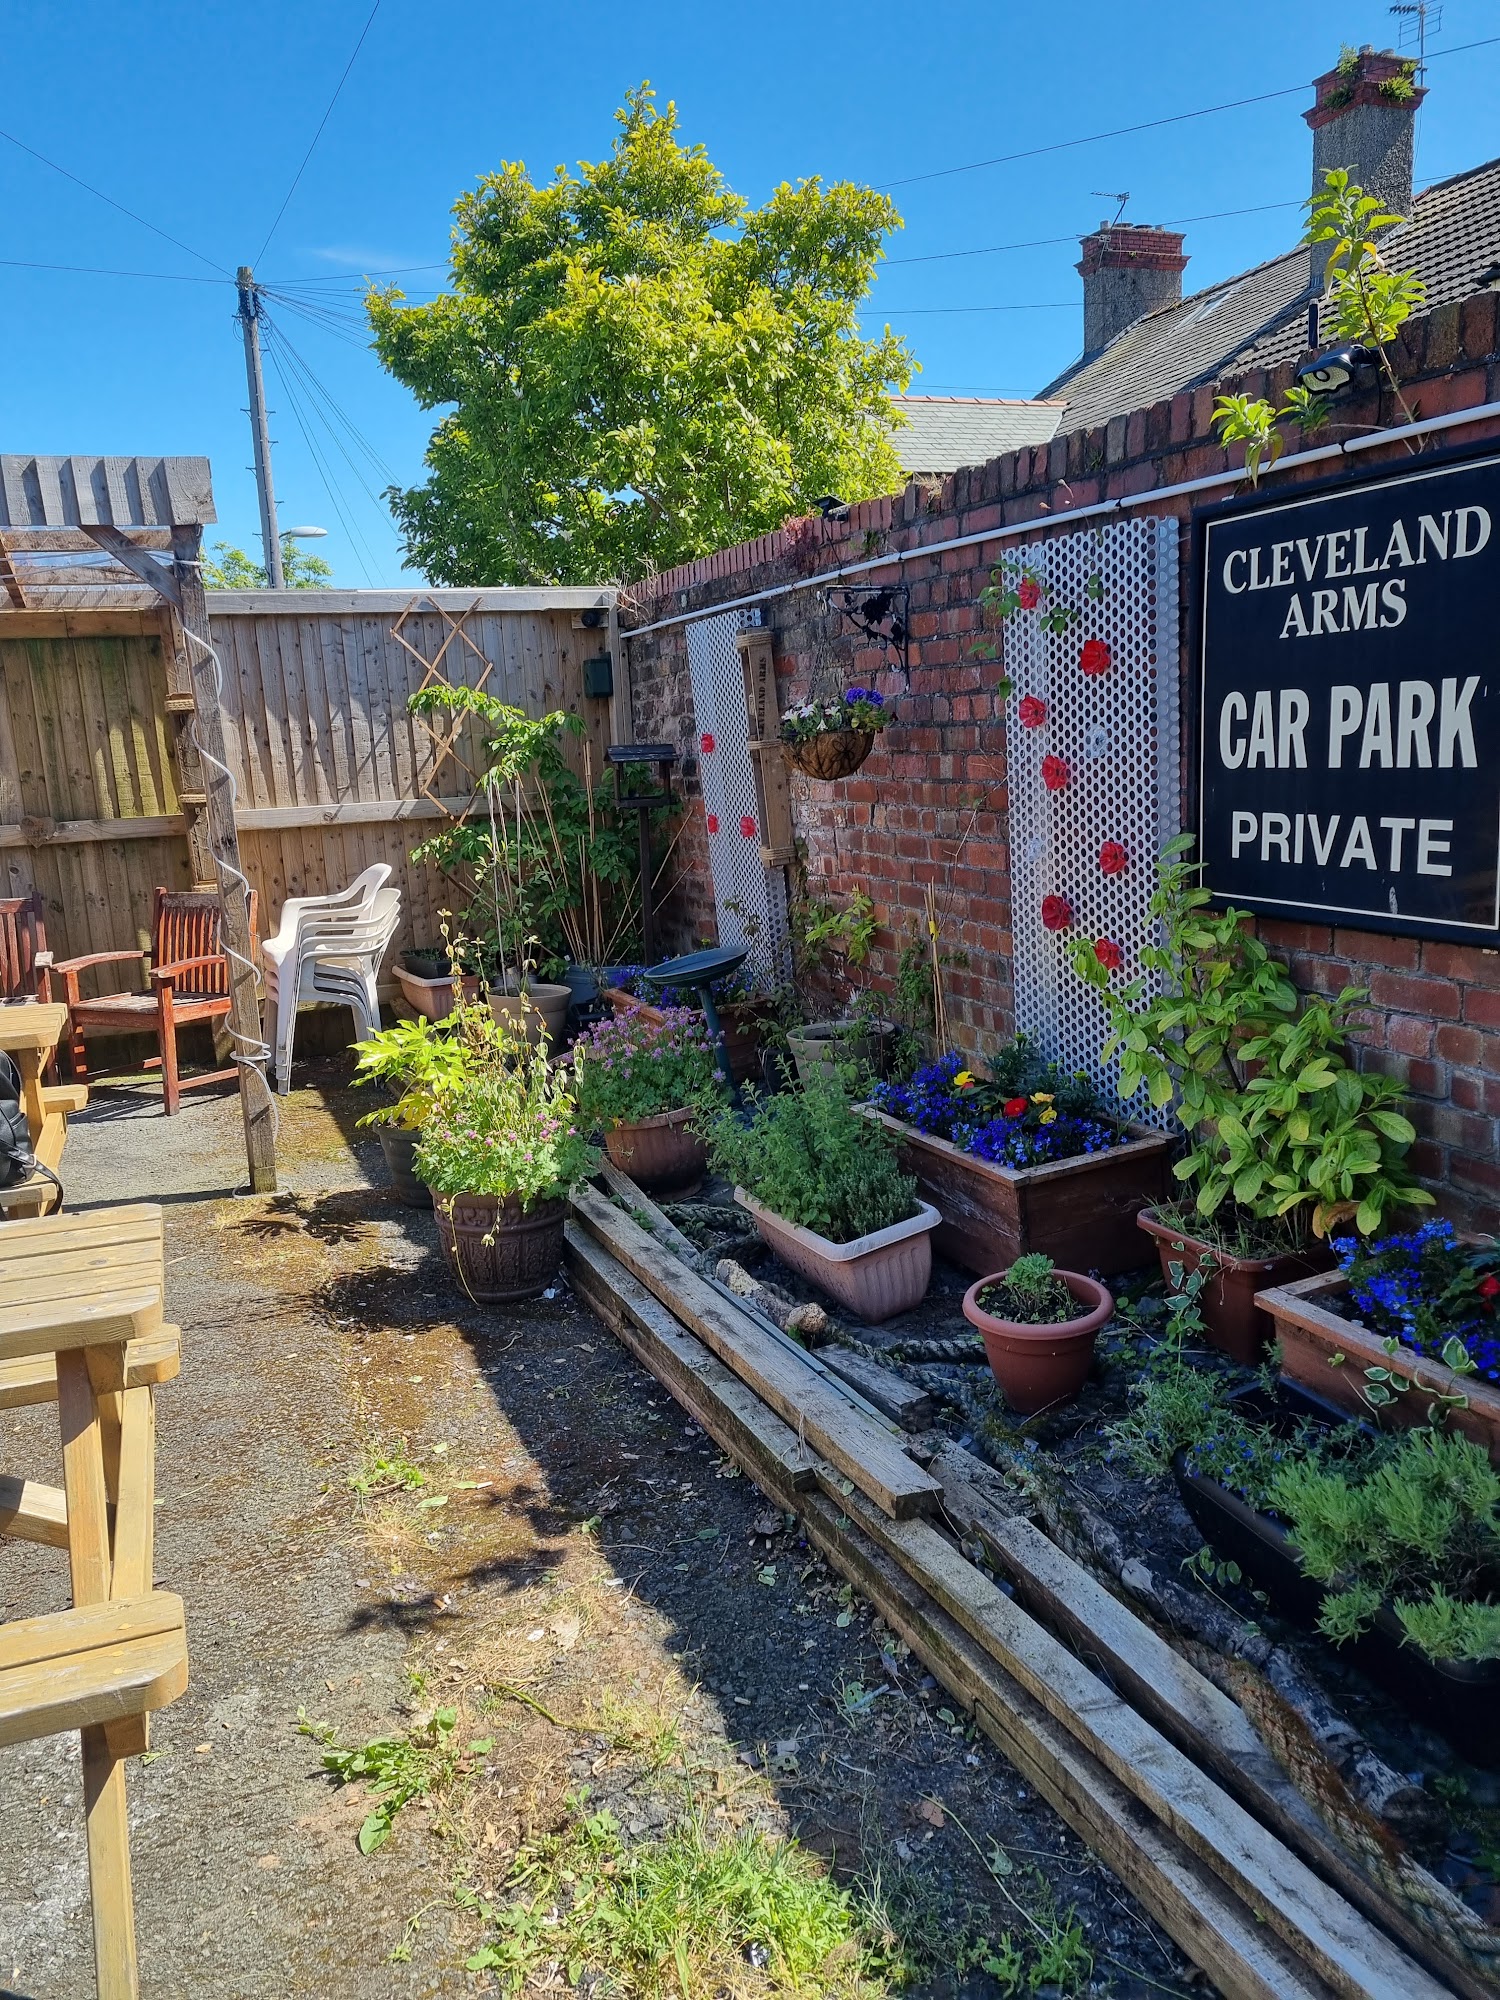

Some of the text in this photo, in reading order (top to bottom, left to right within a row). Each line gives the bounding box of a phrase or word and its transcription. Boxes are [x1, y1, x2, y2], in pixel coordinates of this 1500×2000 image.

[1222, 505, 1492, 594] CLEVELAND
[1279, 578, 1407, 639] ARMS
[758, 657, 767, 741] LEVELAND ARMS
[1219, 675, 1481, 770] CAR PARK
[1231, 810, 1454, 877] PRIVATE
